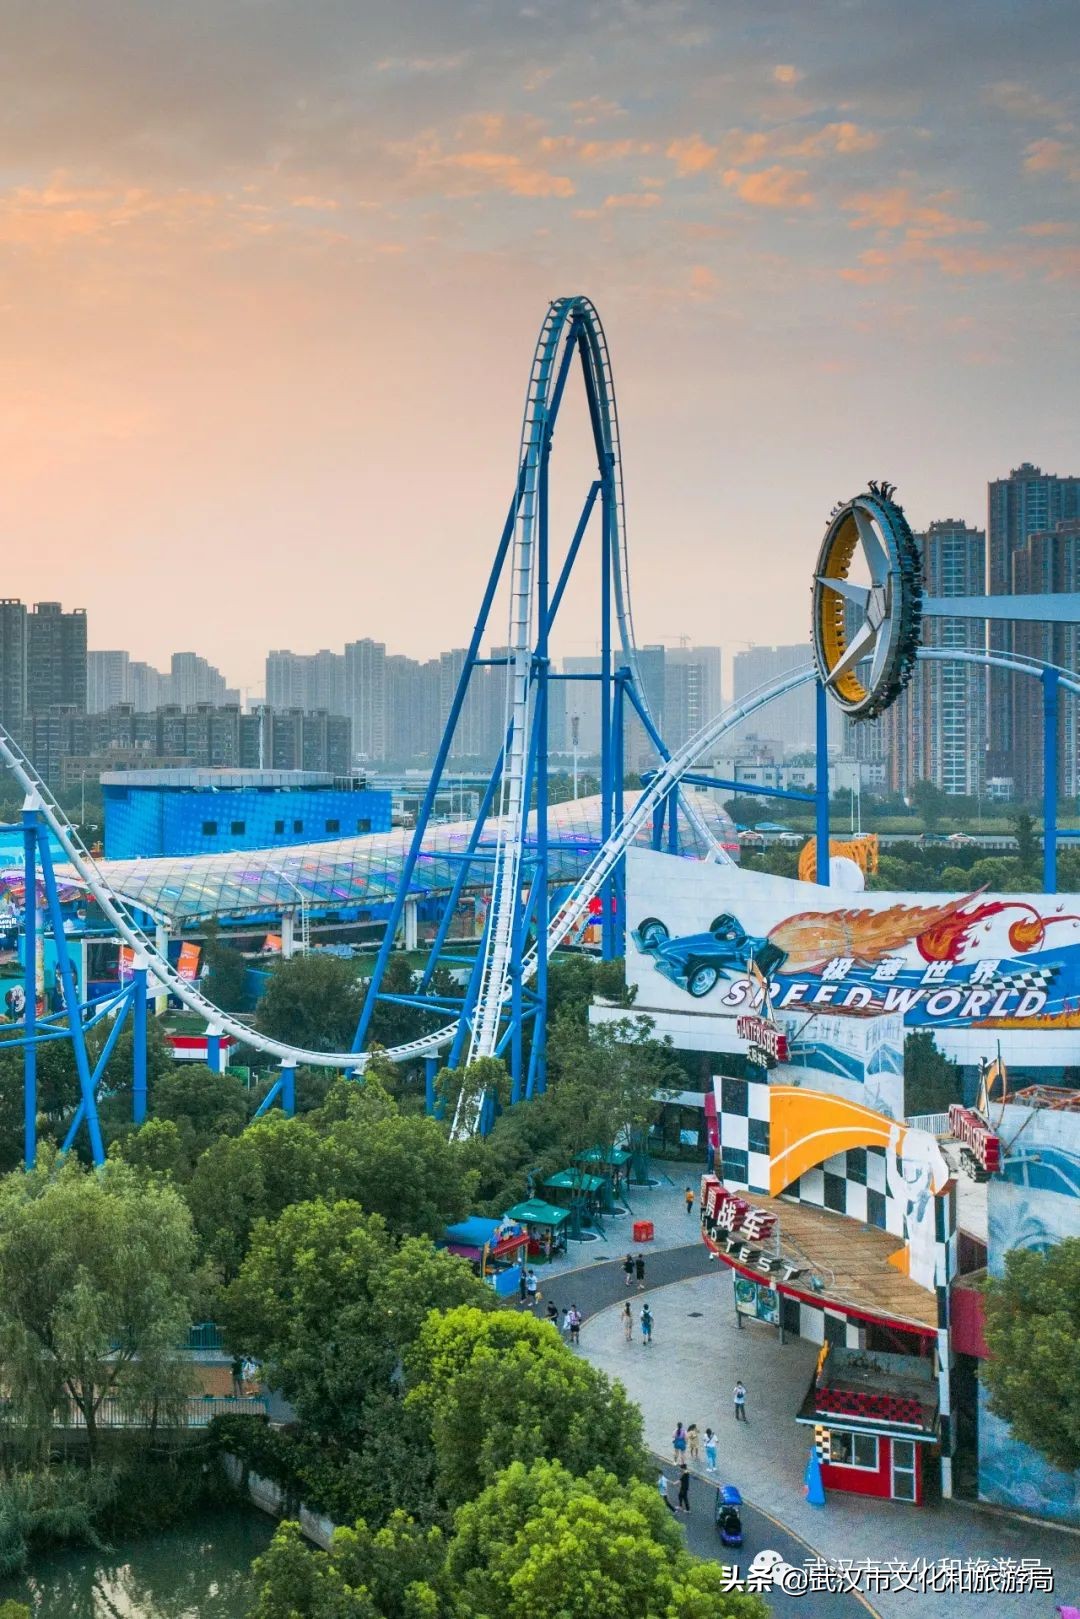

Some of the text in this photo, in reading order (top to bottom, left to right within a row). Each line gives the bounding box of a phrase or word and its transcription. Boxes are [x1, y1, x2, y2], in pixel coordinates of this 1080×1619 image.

[821, 957, 1003, 985] 极速世界
[720, 979, 1048, 1018] SPEED WORLD
[726, 1237, 798, 1281] TEST
